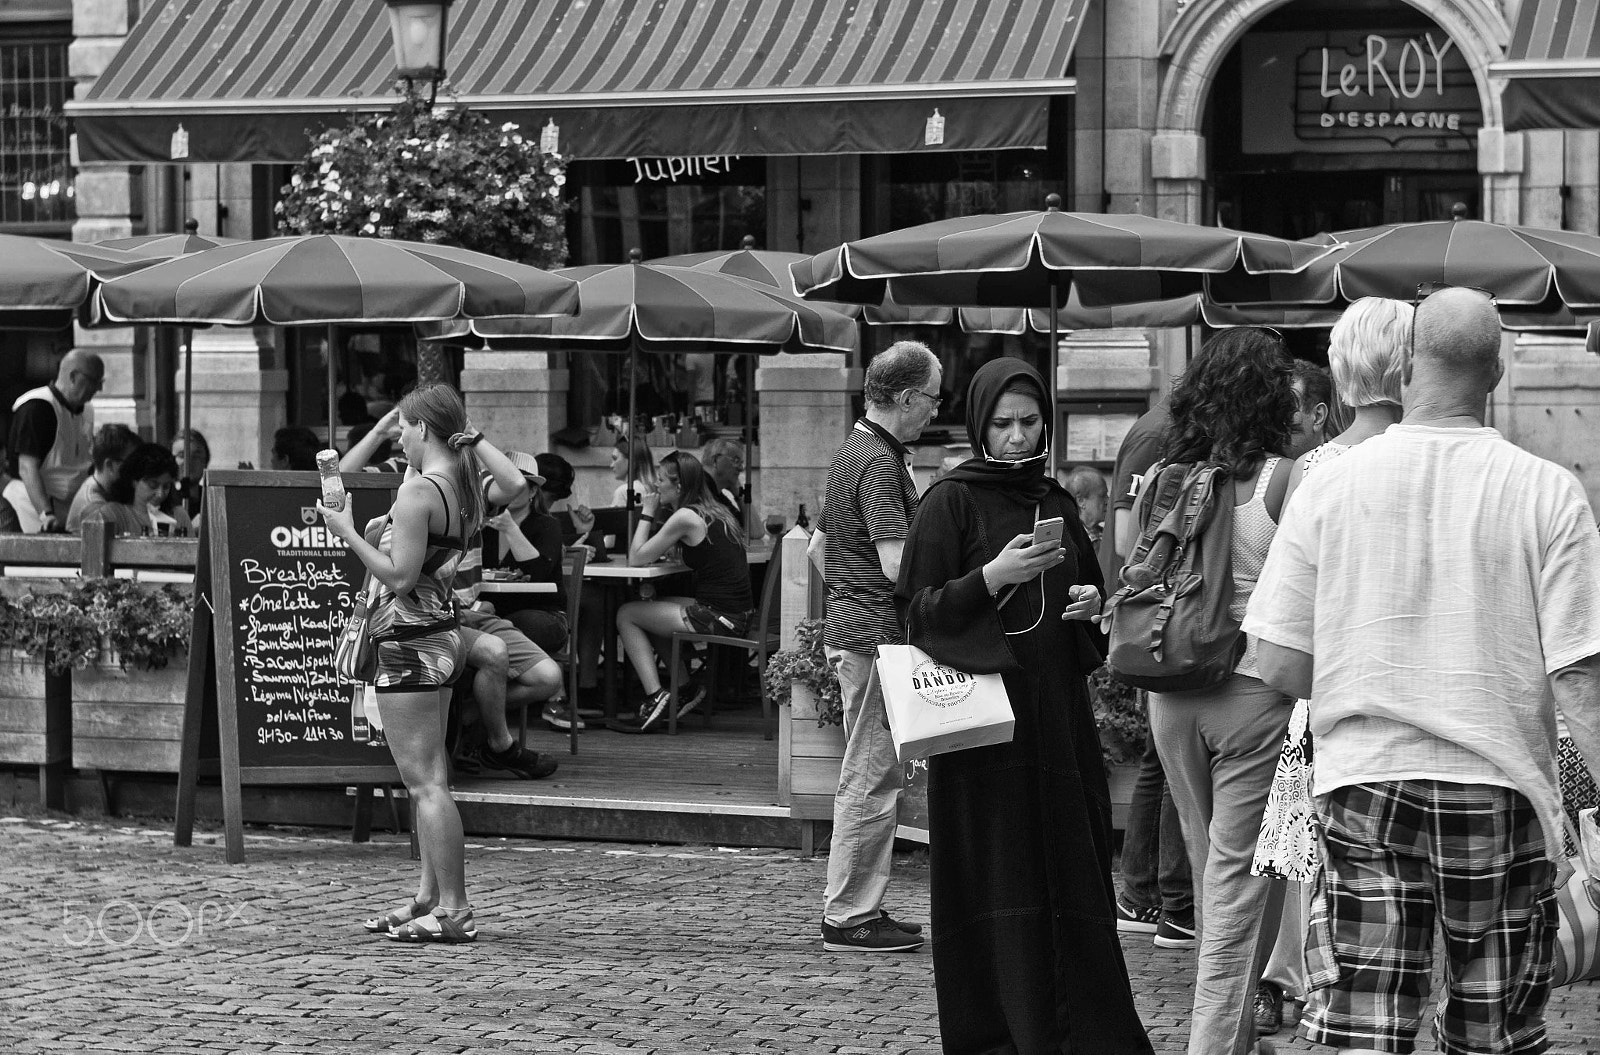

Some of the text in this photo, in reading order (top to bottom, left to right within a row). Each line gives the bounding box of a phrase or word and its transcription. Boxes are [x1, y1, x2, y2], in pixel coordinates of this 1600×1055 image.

[1321, 112, 1461, 130] D'ESPAGNE
[240, 559, 344, 590] Breakfast
[251, 590, 320, 613] Omelette
[922, 669, 961, 677] MAISO
